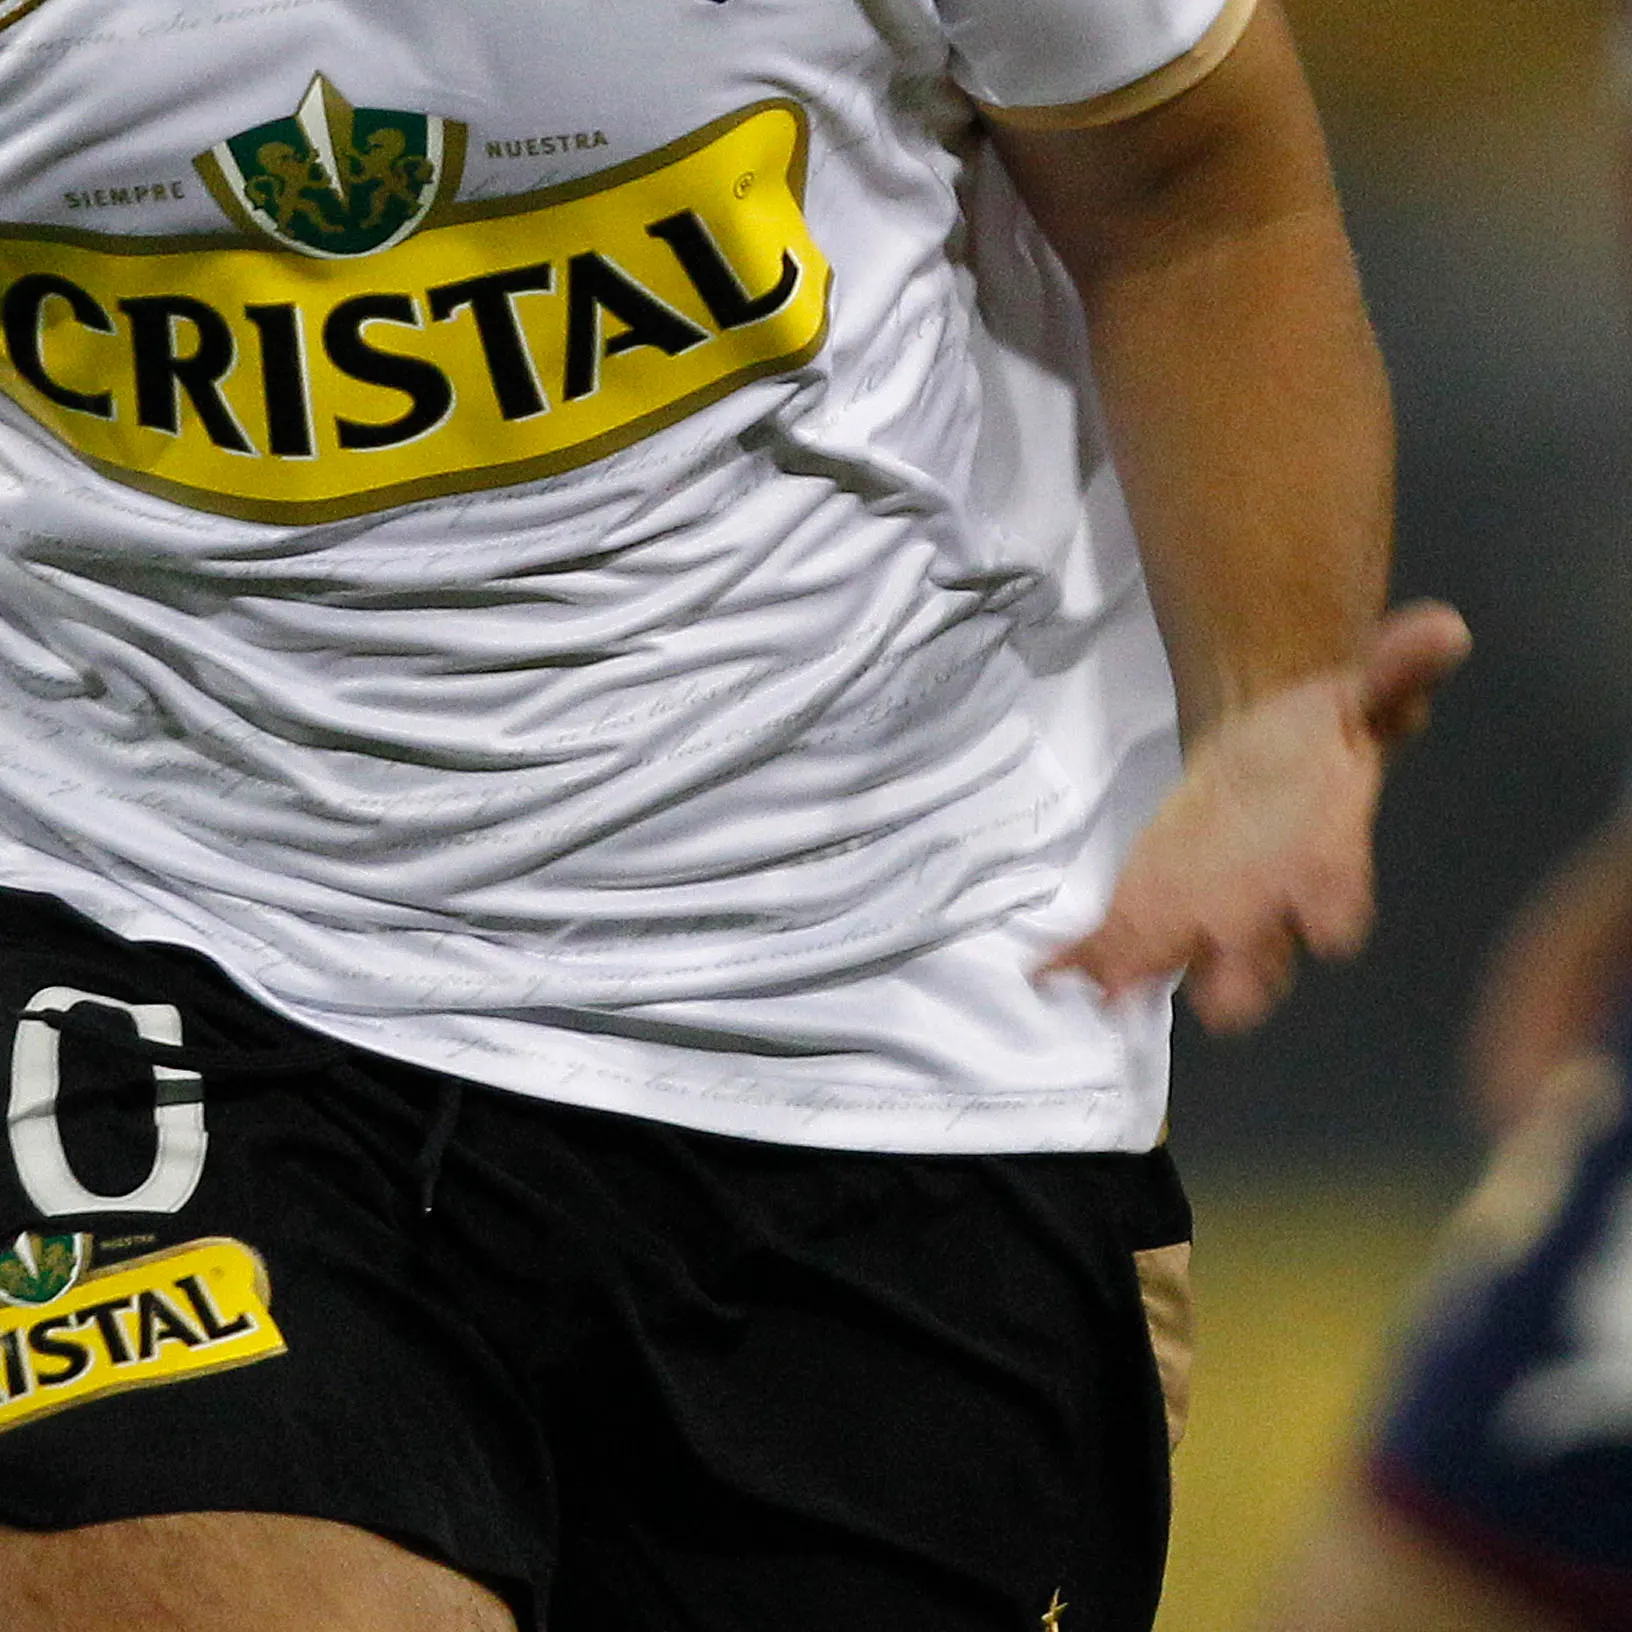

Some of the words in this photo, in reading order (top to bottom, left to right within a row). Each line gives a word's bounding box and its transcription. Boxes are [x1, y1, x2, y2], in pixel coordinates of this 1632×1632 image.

[65, 181, 186, 208] SIEMPRE
[486, 129, 609, 159] NUESTRA
[1, 209, 801, 461] CRISTAL
